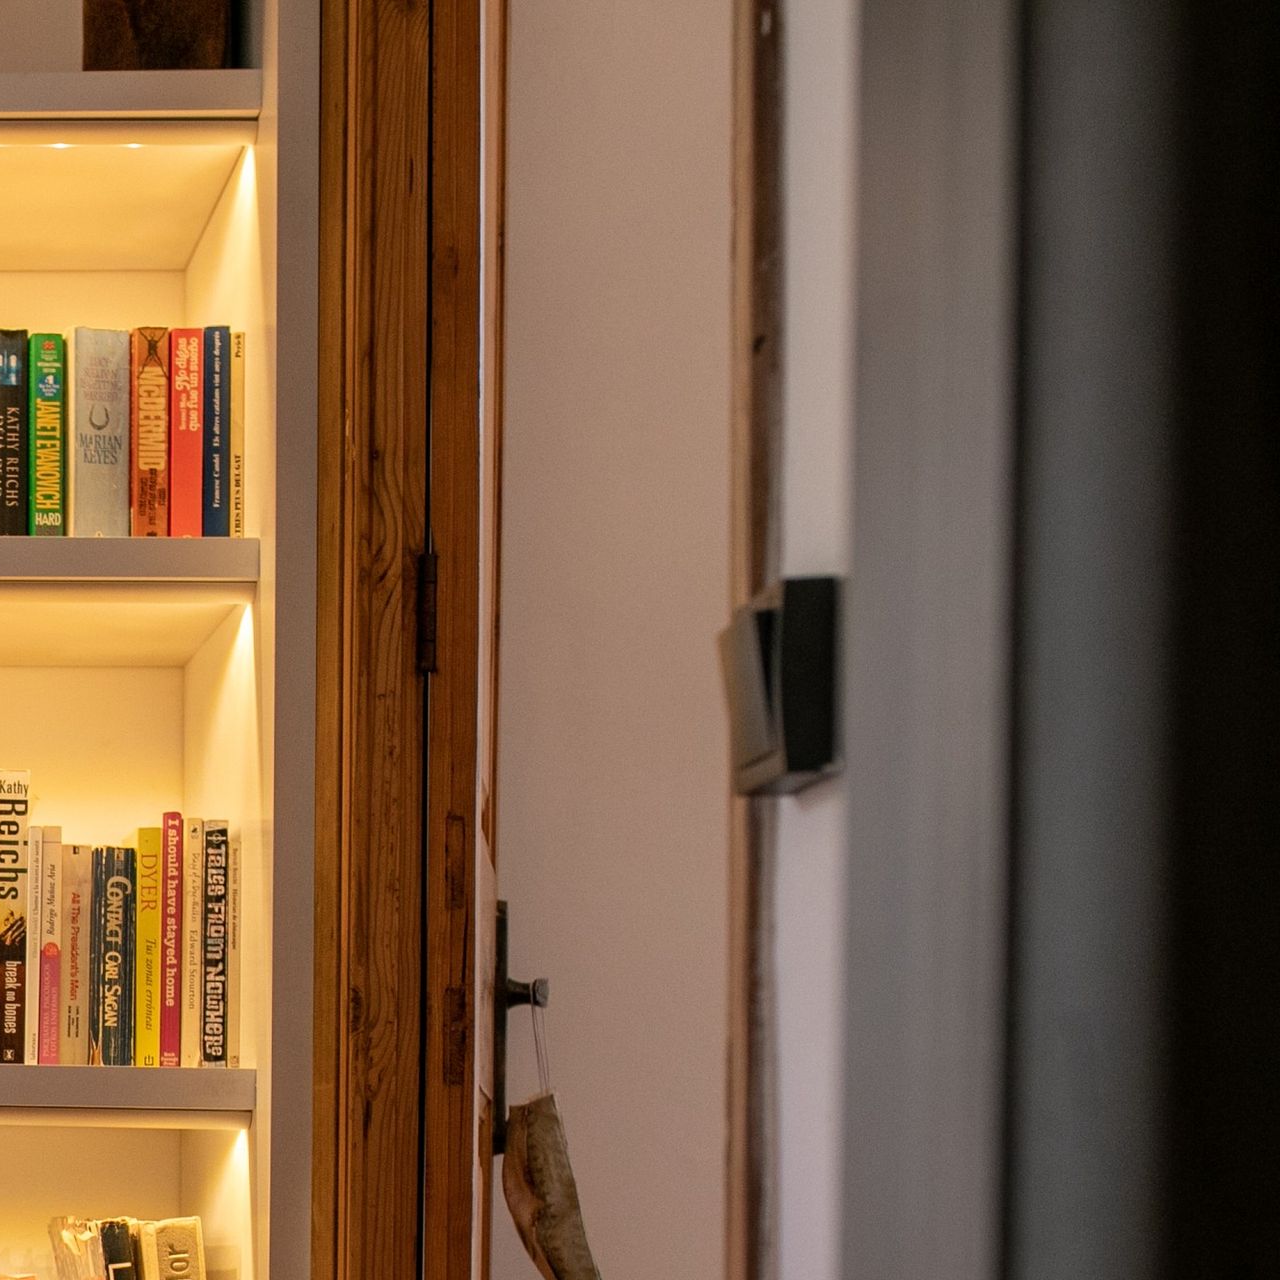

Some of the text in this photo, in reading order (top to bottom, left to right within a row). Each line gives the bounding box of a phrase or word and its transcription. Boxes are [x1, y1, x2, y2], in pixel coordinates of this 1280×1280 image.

[186, 336, 200, 431] que fue un sueño
[36, 398, 61, 438] JANET
[79, 431, 122, 449] MARIAN
[5, 406, 20, 507] KATHY REICHS
[35, 440, 61, 509] EVANOVICH
[82, 449, 118, 465] KEYES
[35, 512, 62, 526] HARD
[0, 779, 29, 798] Kathy
[71, 892, 81, 904] All
[140, 853, 158, 912] DYER
[71, 907, 81, 924] The
[164, 818, 180, 1007] I should have stayed home
[70, 925, 81, 978] President's
[104, 876, 132, 1027] CONTACT CARL SAGAN
[4, 960, 22, 1034] break no bones
[69, 979, 80, 1001] Men
[145, 938, 157, 1031] Tus zonas erróneas
